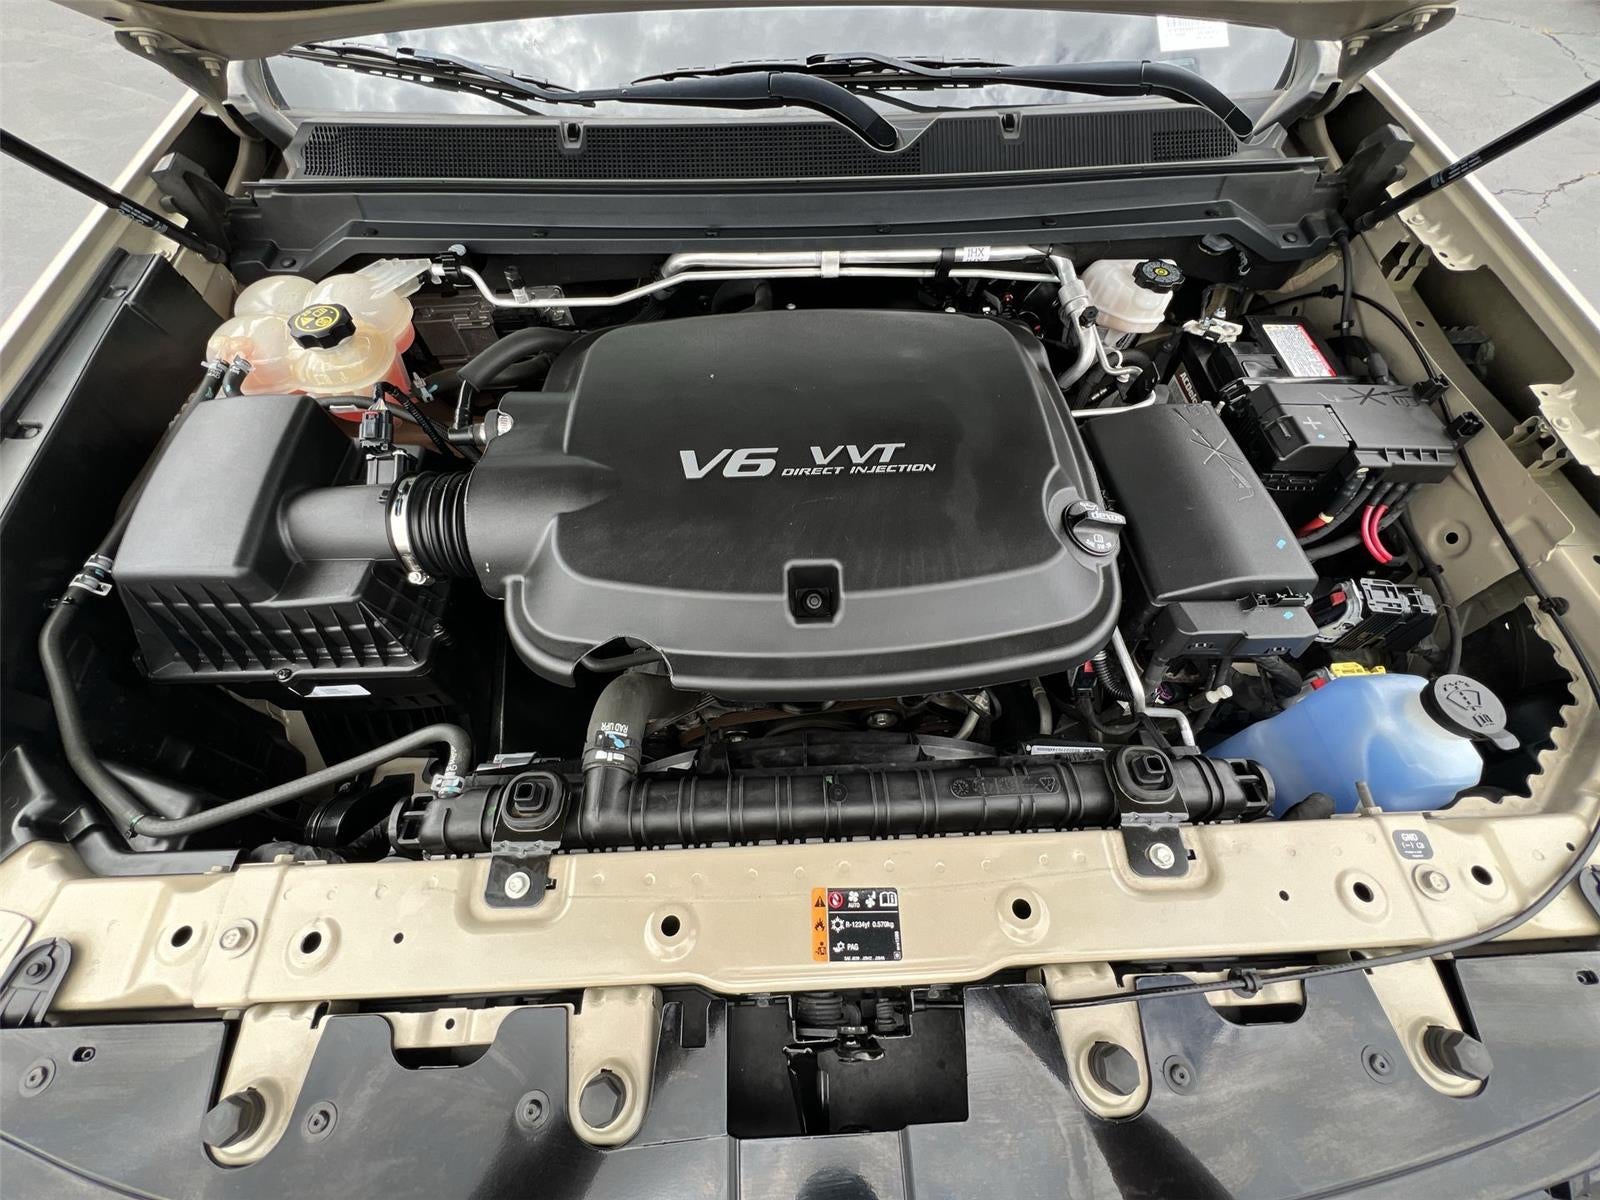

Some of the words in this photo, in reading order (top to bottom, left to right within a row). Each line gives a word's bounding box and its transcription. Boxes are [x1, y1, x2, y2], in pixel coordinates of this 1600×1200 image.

[1180, 371, 1198, 404] ACDelc
[810, 443, 906, 465] VVT
[679, 447, 779, 479] V6
[781, 466, 845, 477] DIRECT
[850, 463, 937, 475] INJECTION
[600, 721, 615, 732] UPR
[614, 722, 629, 734] RAD
[847, 943, 860, 951] PAG
